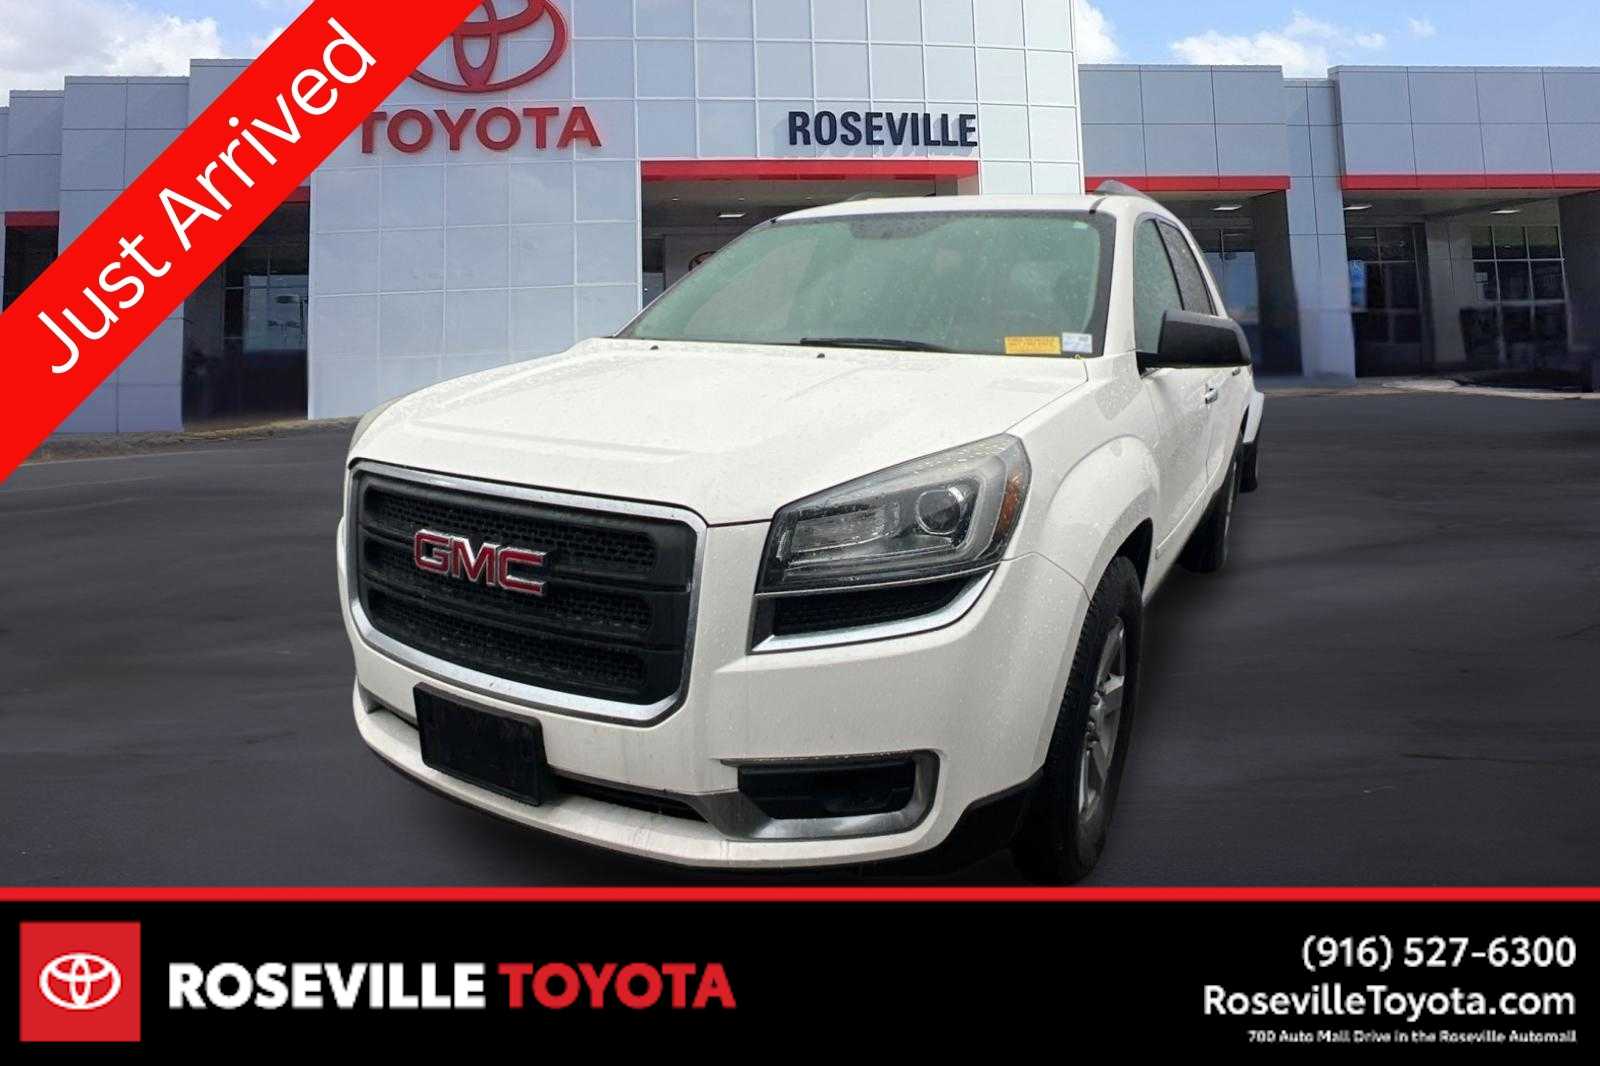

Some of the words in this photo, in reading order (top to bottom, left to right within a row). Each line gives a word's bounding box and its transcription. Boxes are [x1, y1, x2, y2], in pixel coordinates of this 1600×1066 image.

[361, 106, 602, 154] TOYOTA
[788, 110, 978, 148] ROSEVILLE
[413, 528, 548, 597] GMC
